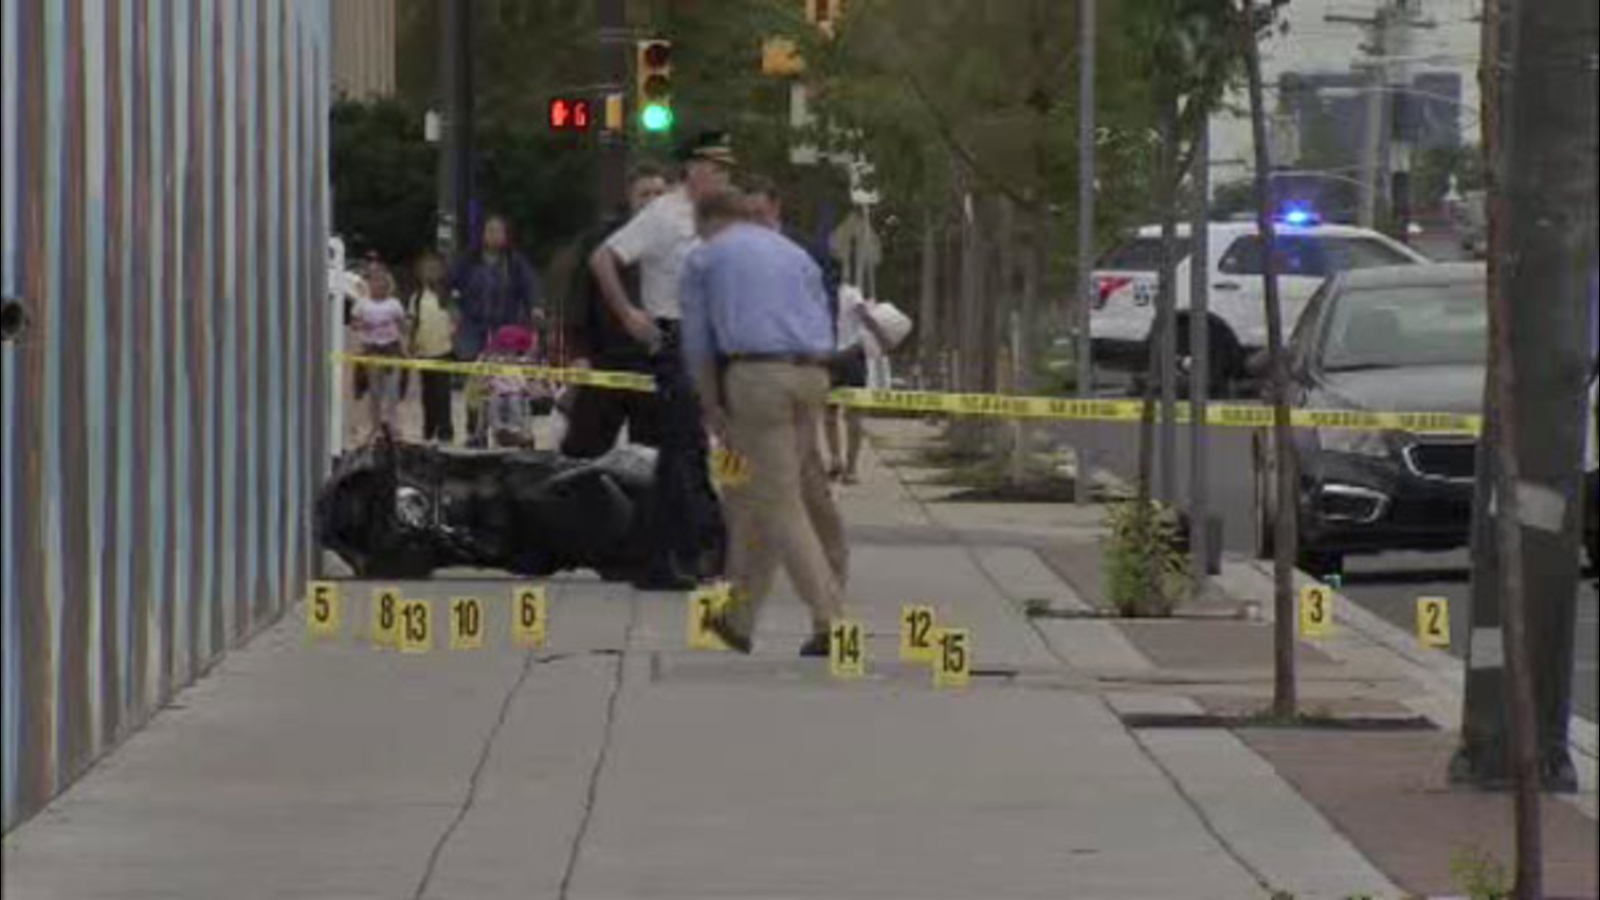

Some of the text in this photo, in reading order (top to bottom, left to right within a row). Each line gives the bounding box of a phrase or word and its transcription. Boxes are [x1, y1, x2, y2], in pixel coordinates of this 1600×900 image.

[314, 587, 330, 622] 5
[380, 592, 395, 629] 8
[402, 602, 427, 642] 13
[453, 599, 479, 636] 10
[520, 592, 536, 627] 6
[1308, 589, 1324, 624] 3
[1425, 602, 1441, 635] 2
[833, 625, 860, 664] 14
[905, 610, 932, 648] 12
[938, 634, 964, 673] 15
